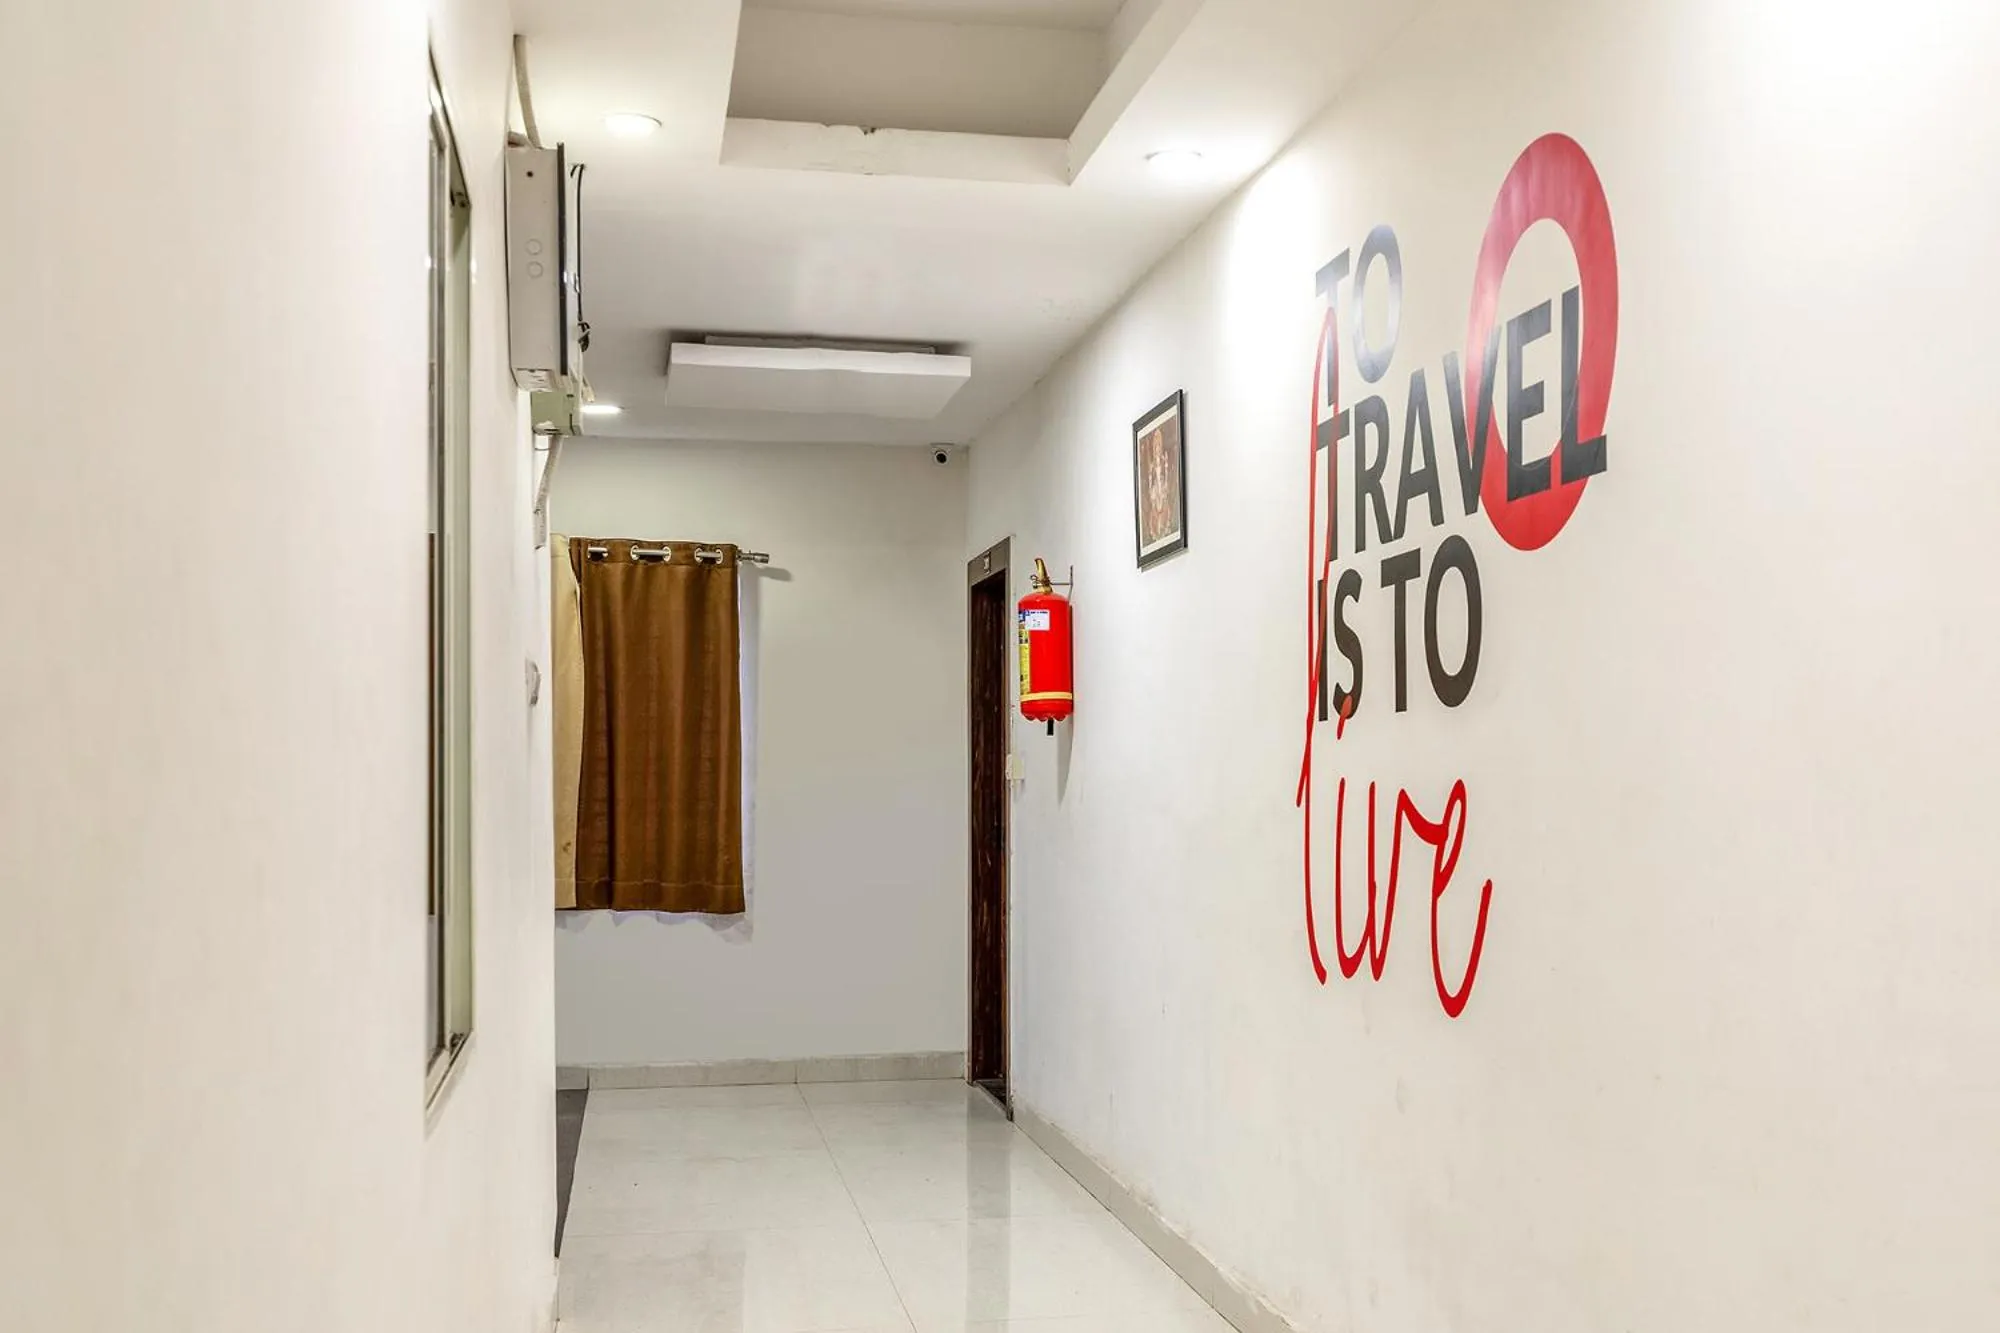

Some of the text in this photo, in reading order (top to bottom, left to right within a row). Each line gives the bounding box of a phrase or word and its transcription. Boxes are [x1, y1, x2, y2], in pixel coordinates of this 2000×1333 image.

[1316, 223, 1402, 406] TO
[1316, 285, 1607, 562] TRAVEL
[1317, 534, 1482, 721] IS TO
